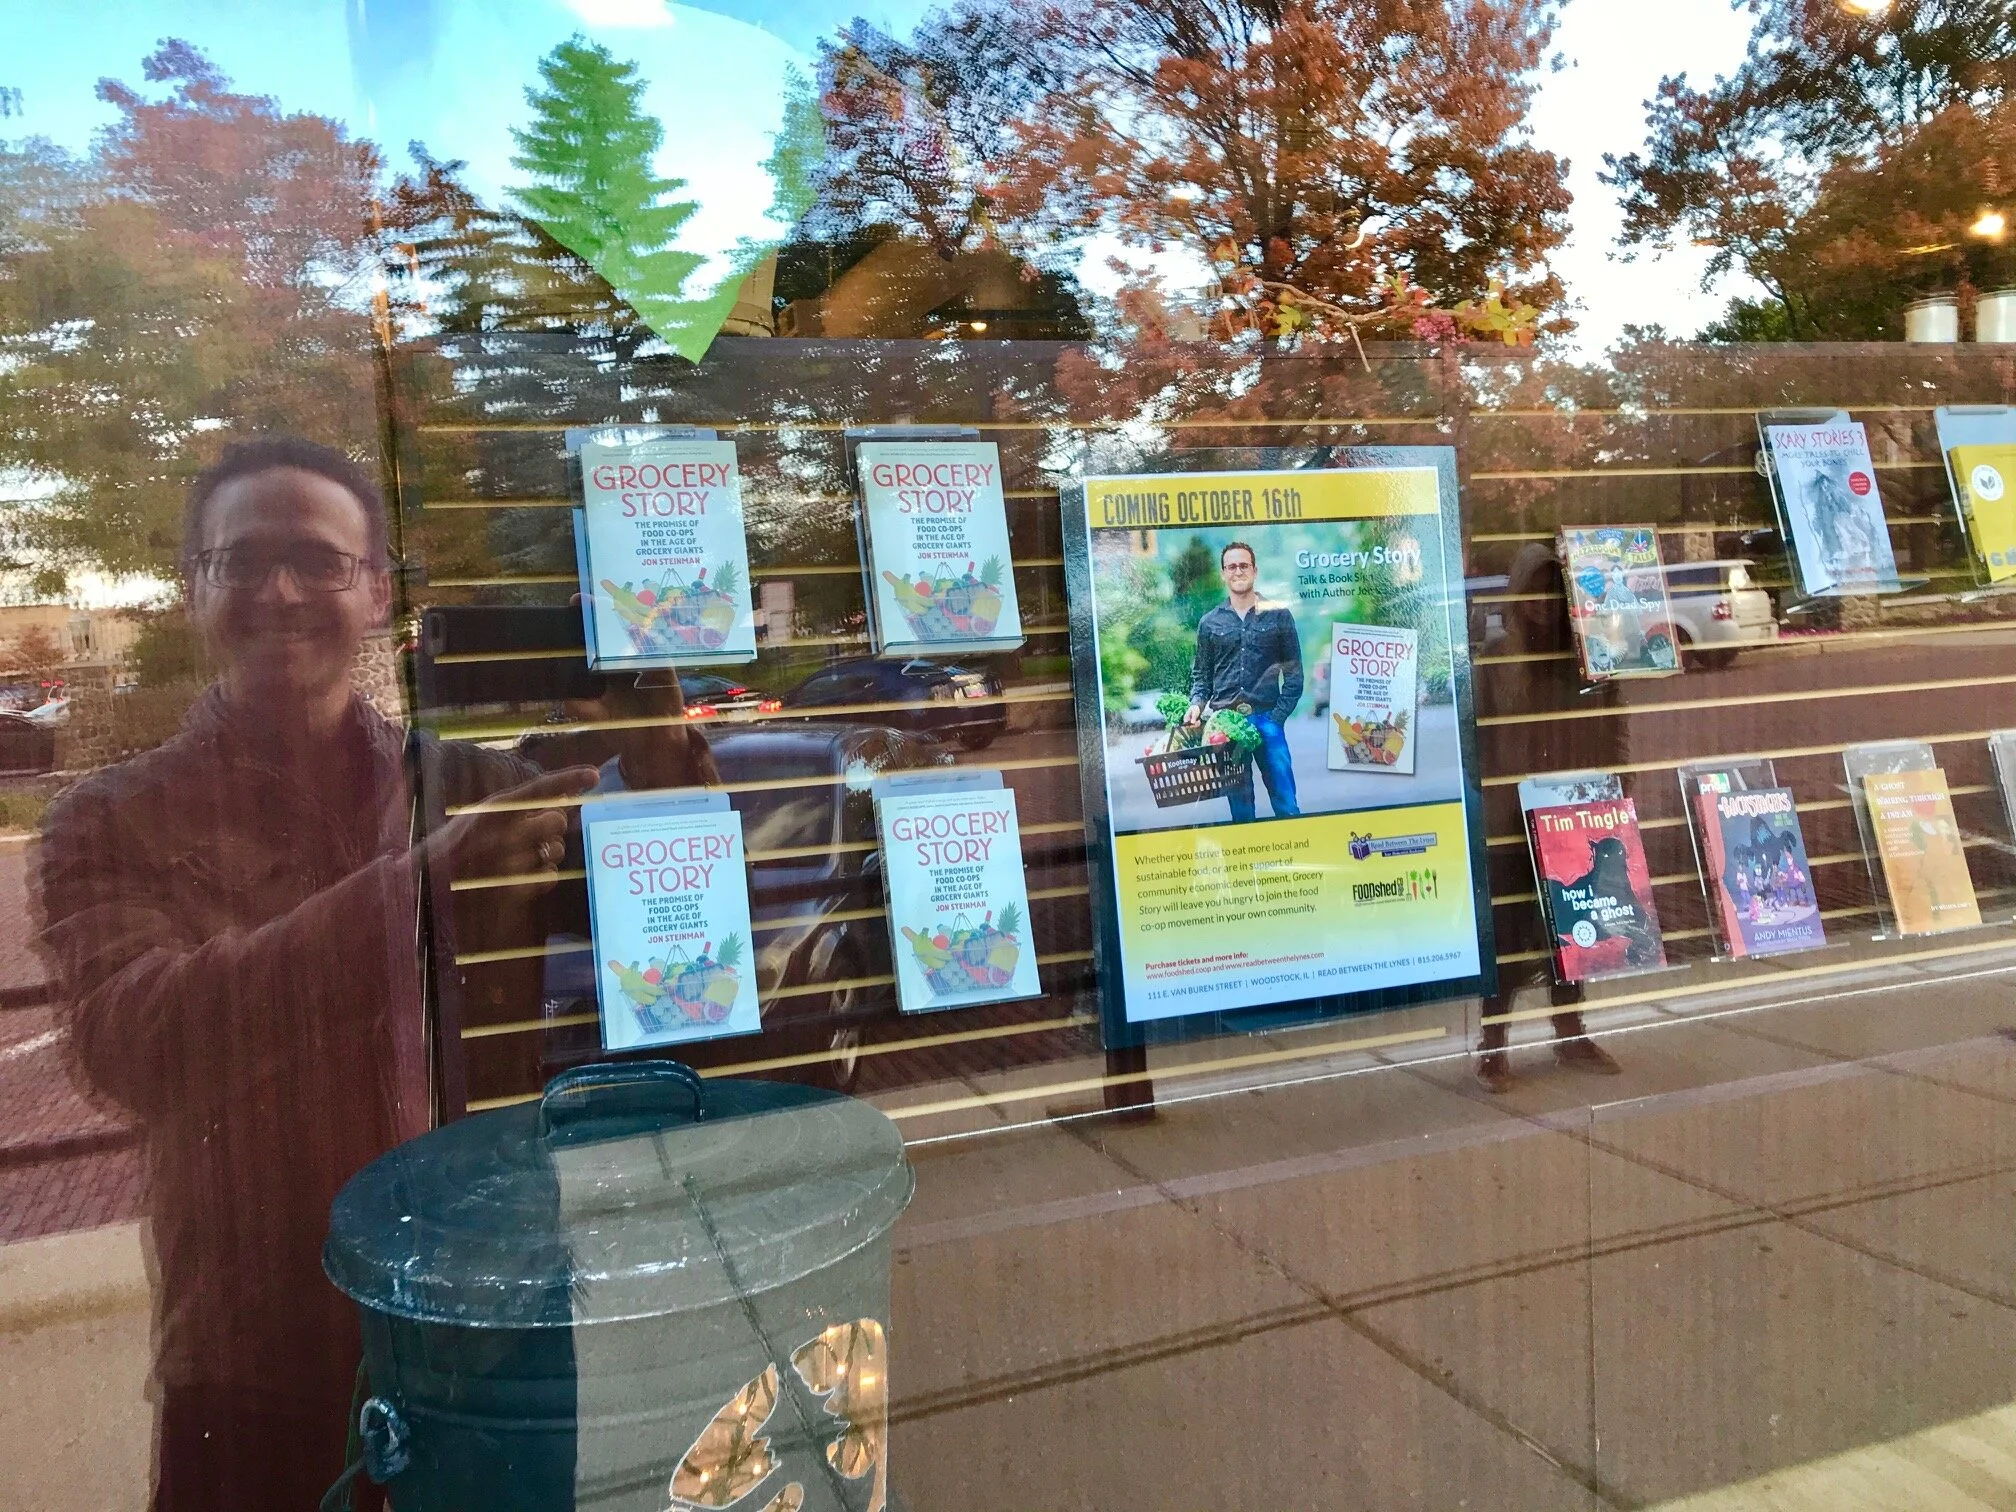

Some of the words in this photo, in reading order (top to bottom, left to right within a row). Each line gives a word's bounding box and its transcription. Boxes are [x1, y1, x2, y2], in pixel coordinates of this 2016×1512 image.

[1775, 431, 1806, 449] SCARY
[1811, 429, 1854, 447] STORIES
[1857, 431, 1864, 446] 3
[1843, 448, 1864, 456] CHILL
[593, 463, 730, 490] GROCERY
[873, 463, 993, 487] GROCERY
[621, 490, 709, 517] STORY
[898, 490, 975, 513] STORY
[1103, 492, 1171, 526] COMING
[1177, 489, 1255, 523] OCTOBER
[1262, 488, 1303, 519] 16th
[1295, 549, 1369, 569] Grocery
[1373, 545, 1421, 565] Story
[1298, 575, 1317, 585] Talk
[1320, 574, 1327, 584] &
[1328, 573, 1353, 583] Book
[1300, 589, 1320, 599] with
[1322, 587, 1355, 597] Author
[1585, 600, 1608, 611] One
[1610, 599, 1637, 610] Dead
[1639, 598, 1660, 611] Spy
[1337, 638, 1413, 660] GROCERY
[1350, 658, 1399, 677] STORY
[892, 810, 1010, 841] GROCERY
[1540, 815, 1574, 832] Tim
[1576, 807, 1629, 830] Tingle
[601, 834, 736, 868] GROCERY
[917, 837, 992, 866] STORY
[1135, 854, 1174, 865] Whether
[1177, 853, 1193, 863] you
[1195, 849, 1219, 859] strive
[1222, 848, 1230, 856] to
[1233, 846, 1246, 856] eat
[1248, 845, 1270, 854] more
[1272, 841, 1292, 851] local
[1294, 838, 1309, 849] and
[628, 863, 714, 895] STORY
[945, 866, 974, 875] PROMISE
[956, 874, 980, 882] CO-OPS
[1137, 869, 1186, 882] sustainable
[1240, 862, 1248, 870] in
[1249, 858, 1282, 870] support
[1284, 857, 1293, 866] of
[974, 882, 982, 890] OF
[1138, 885, 1187, 898] community
[1189, 880, 1233, 893] economic
[1233, 875, 1291, 888] development,
[1293, 872, 1323, 881] Grocery
[1352, 880, 1397, 900] FOODshed
[1562, 888, 1586, 901] how
[1588, 884, 1593, 897] i
[642, 898, 657, 906] THE
[660, 895, 692, 904] PROMISE
[931, 894, 961, 902] GROCERY
[963, 891, 989, 899] GIANTS
[1139, 906, 1161, 915] Story
[1163, 902, 1178, 912] will
[1180, 901, 1203, 910] leave
[1205, 899, 1221, 909] you
[1223, 895, 1253, 905] hungry
[1255, 893, 1264, 902] to
[1266, 891, 1282, 902] join
[1284, 889, 1298, 898] the
[1300, 886, 1319, 897] food
[1572, 896, 1617, 911] became
[672, 903, 699, 912] CO-OPS
[936, 904, 949, 912] JON
[1141, 922, 1166, 931] co-op
[1168, 915, 1214, 928] movement
[1216, 913, 1224, 922] in
[1226, 912, 1246, 923] your
[1248, 910, 1266, 919] own
[1268, 904, 1317, 917] community.
[1591, 910, 1598, 920] a
[1601, 904, 1634, 921] ghost
[642, 924, 677, 933] GROCERY
[680, 920, 708, 930] GIANTS
[647, 916, 655, 924] IN
[675, 913, 690, 921] AGE
[1755, 930, 1776, 941] ANDY
[1778, 926, 1812, 938] MIENTUS
[1145, 961, 1177, 971] Purchase
[1177, 958, 1200, 967] tickets
[1201, 956, 1214, 964] and
[1215, 954, 1232, 962] more
[1234, 951, 1249, 960] info:
[1146, 966, 1212, 980] www.foodshed.coop
[1212, 963, 1225, 971] and
[1225, 951, 1325, 970] www.readbetweenthelynes.com
[1147, 991, 1161, 1000] 111
[1163, 990, 1169, 998] E.
[1171, 987, 1187, 997] VAN
[1189, 984, 1214, 995] BUREN
[1216, 981, 1242, 991] STREET
[1250, 972, 1302, 986] WOODSTOCK,
[1303, 971, 1310, 980] IL
[1317, 968, 1337, 977] READ
[1339, 963, 1373, 975] BETWEEN
[1389, 958, 1410, 968] LYNES
[1417, 951, 1461, 964] 815.206.5967
